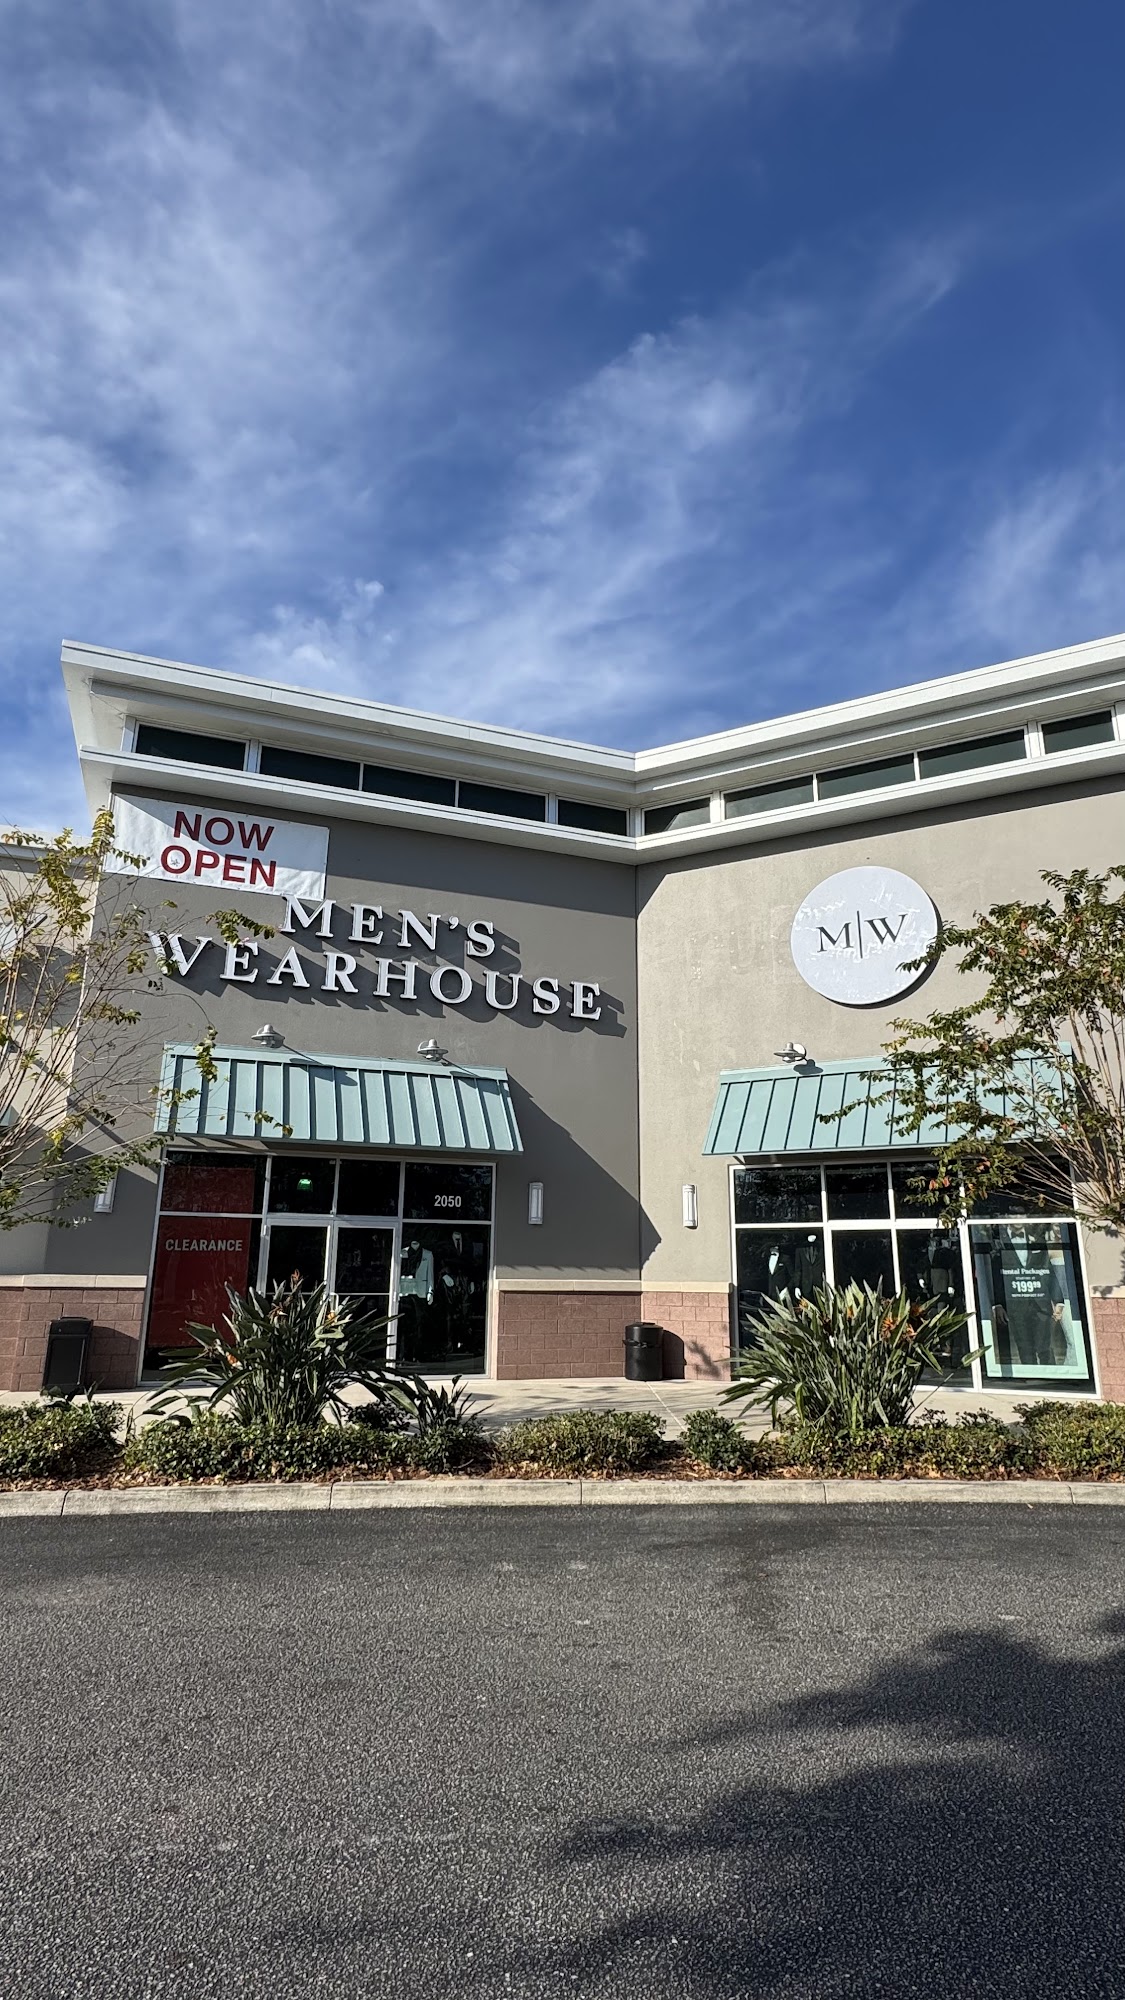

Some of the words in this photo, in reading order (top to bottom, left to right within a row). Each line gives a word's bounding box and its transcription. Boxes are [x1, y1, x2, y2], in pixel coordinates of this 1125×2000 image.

[173, 810, 275, 852] NOW
[160, 845, 277, 888] OPEN
[279, 894, 495, 958] MEN'S
[145, 931, 602, 1021] WEARHOUSE
[433, 1194, 462, 1208] 2050
[165, 1238, 244, 1252] CLEARANCE
[1021, 1268, 1050, 1276] Packages
